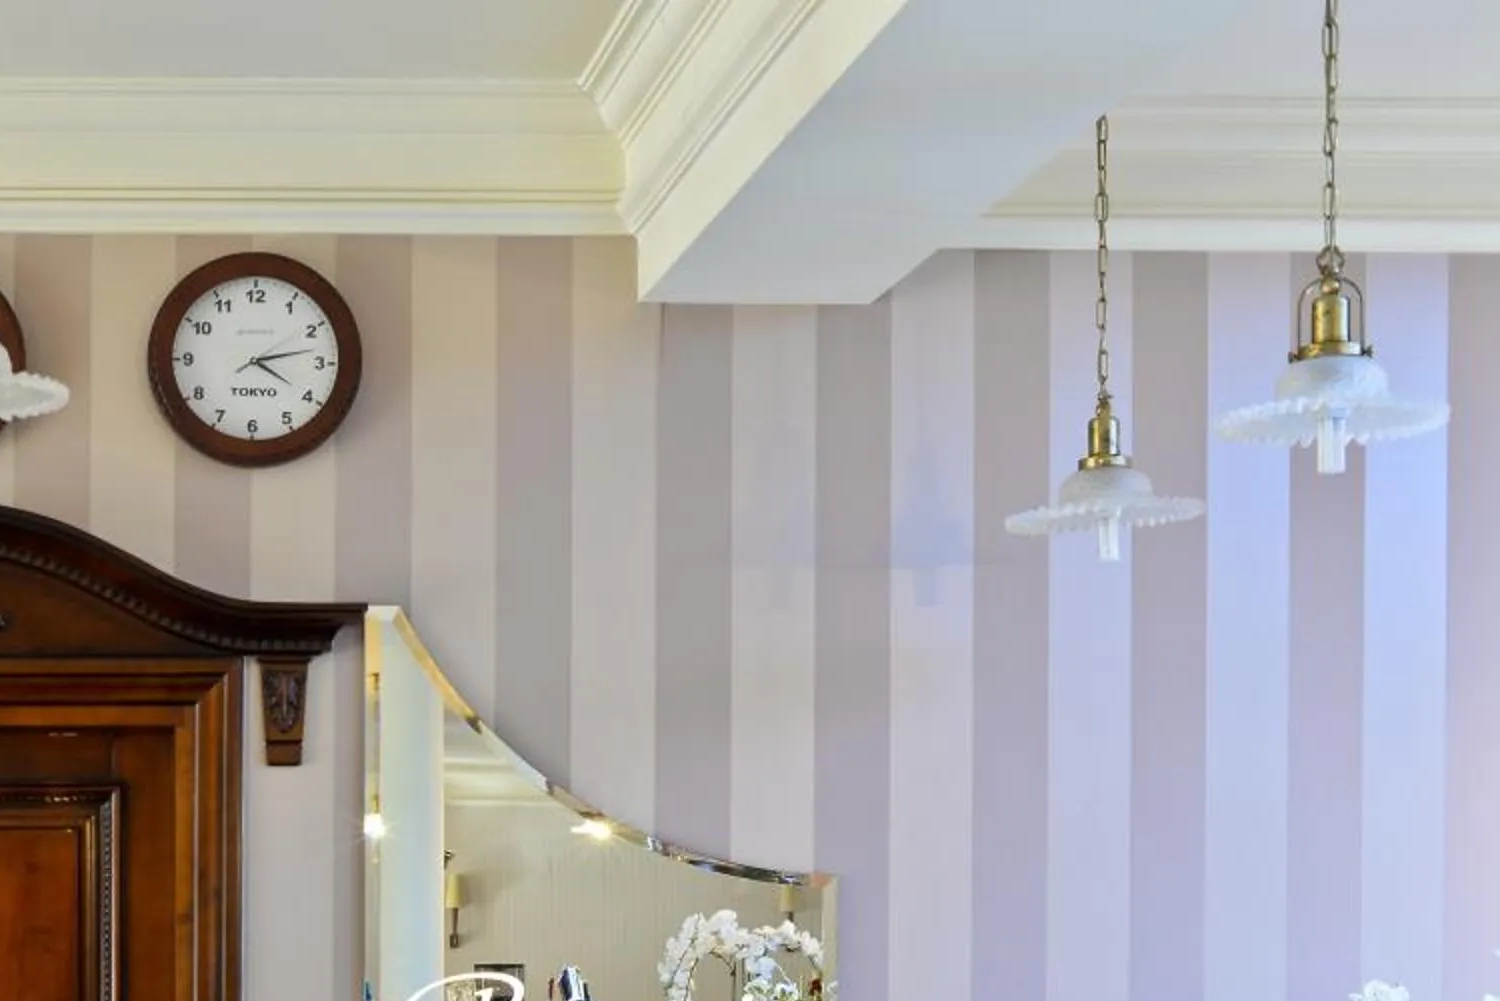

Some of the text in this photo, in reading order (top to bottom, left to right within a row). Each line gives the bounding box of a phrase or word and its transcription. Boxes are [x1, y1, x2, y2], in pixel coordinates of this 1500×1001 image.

[246, 290, 266, 303] 12
[215, 300, 232, 313] 11
[285, 301, 293, 315] 1
[193, 322, 212, 335] 10
[306, 325, 317, 338] 2
[183, 353, 194, 366] 9
[315, 356, 325, 370] 3
[193, 387, 205, 400] 8
[231, 387, 277, 397] TOKYO
[302, 390, 313, 403] 4
[215, 409, 226, 422] 7
[281, 411, 292, 424] 5
[247, 420, 258, 433] 6
